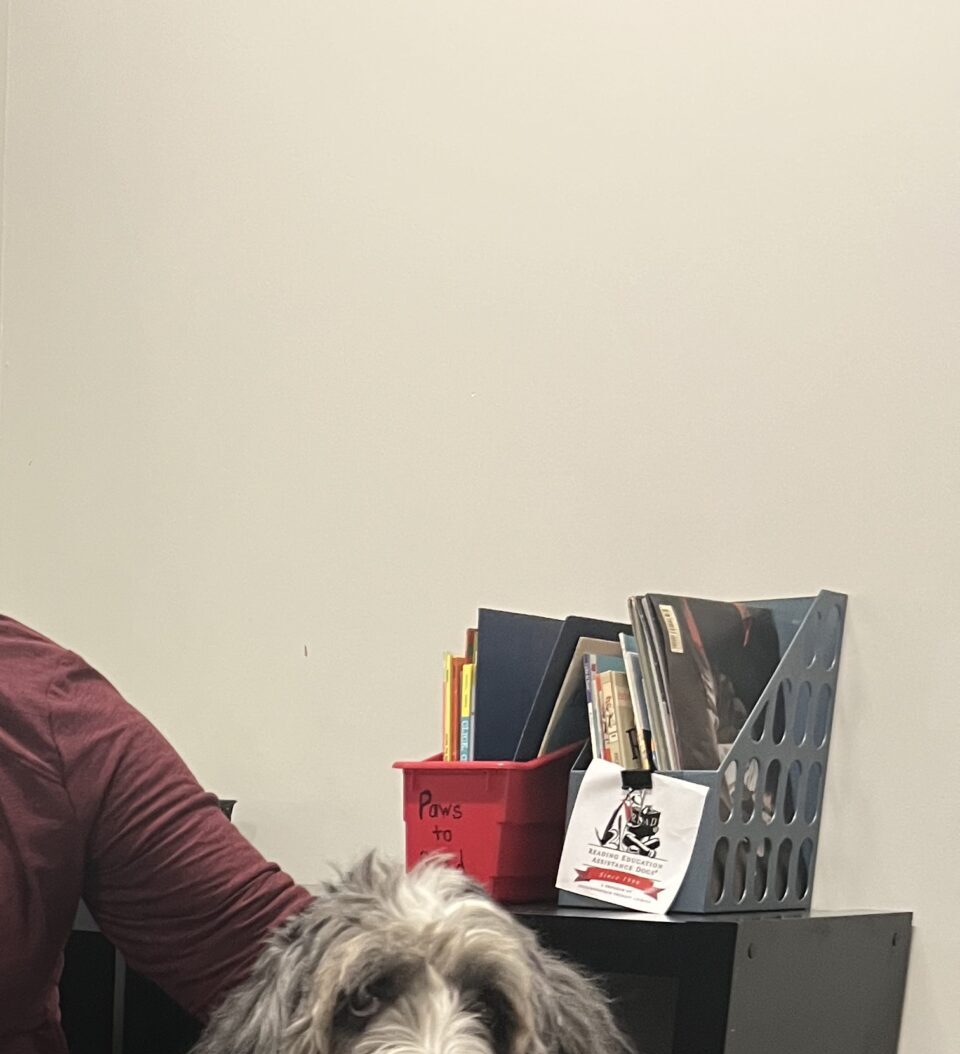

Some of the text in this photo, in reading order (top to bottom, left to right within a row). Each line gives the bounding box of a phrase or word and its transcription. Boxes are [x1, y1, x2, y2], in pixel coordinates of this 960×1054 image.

[419, 789, 463, 820] Paws
[432, 825, 452, 842] to
[588, 848, 663, 869] READING EDUCATION
[592, 857, 633, 871] ASSISTANCE
[598, 871, 620, 881] Since
